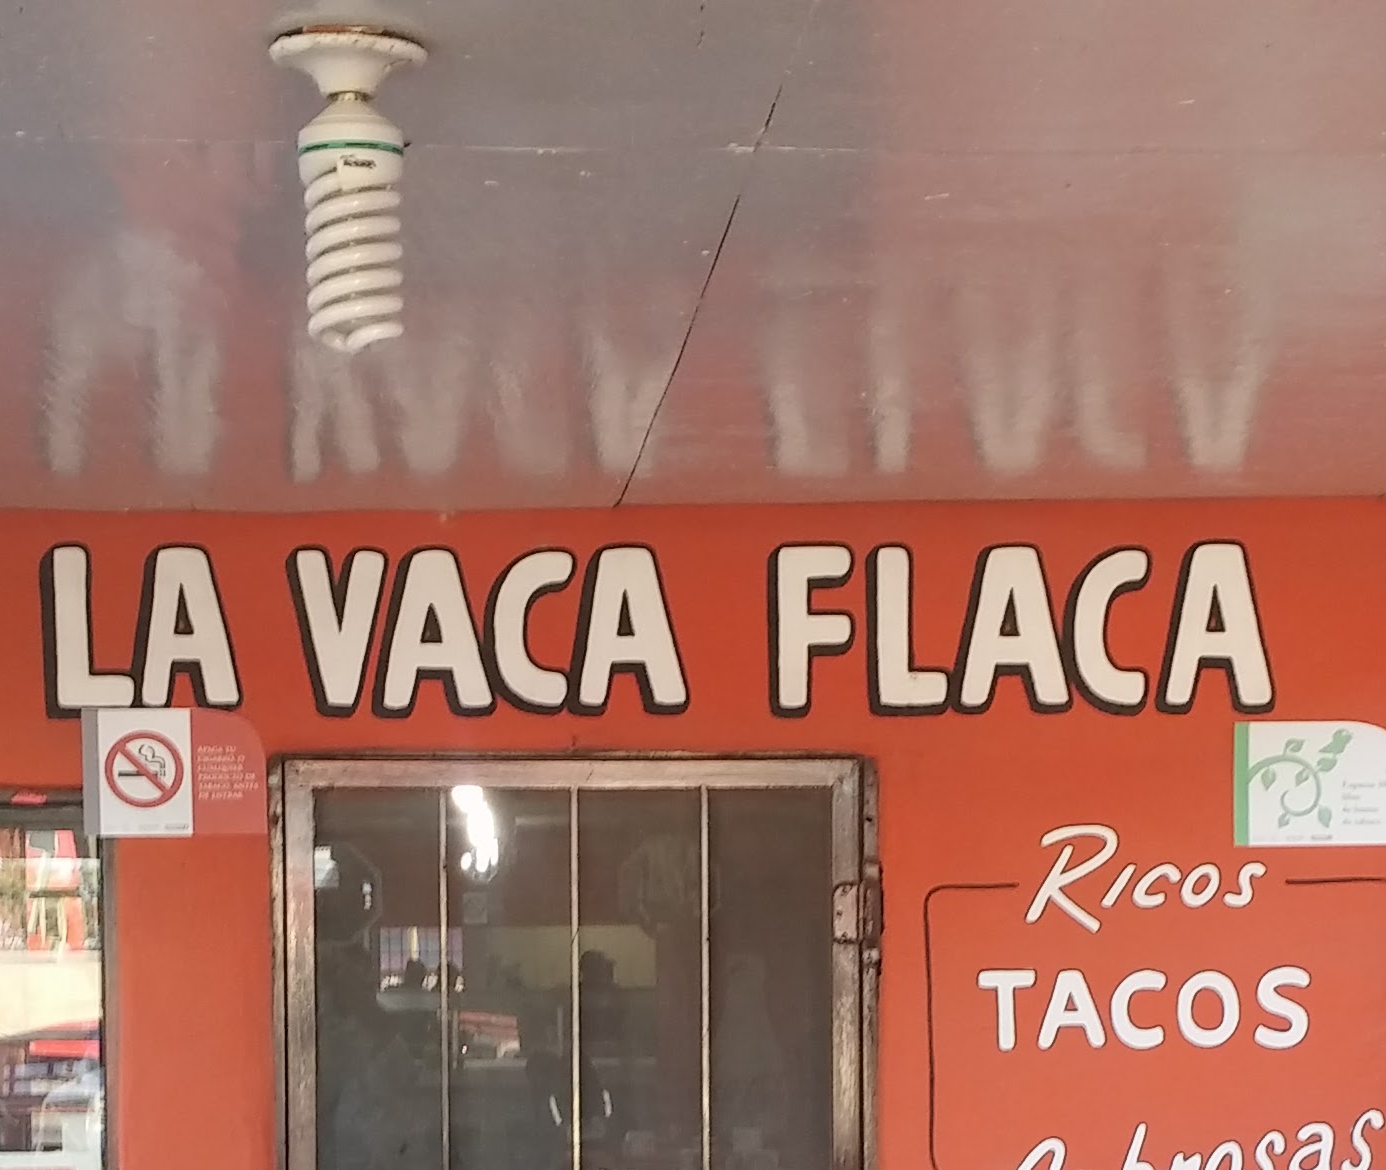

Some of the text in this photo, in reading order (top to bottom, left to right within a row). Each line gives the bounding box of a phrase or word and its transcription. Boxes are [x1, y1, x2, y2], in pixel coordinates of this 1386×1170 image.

[39, 542, 242, 718] LA
[286, 543, 690, 718] VACA
[767, 540, 1275, 717] FLACA
[977, 965, 1312, 1051] TACOS
